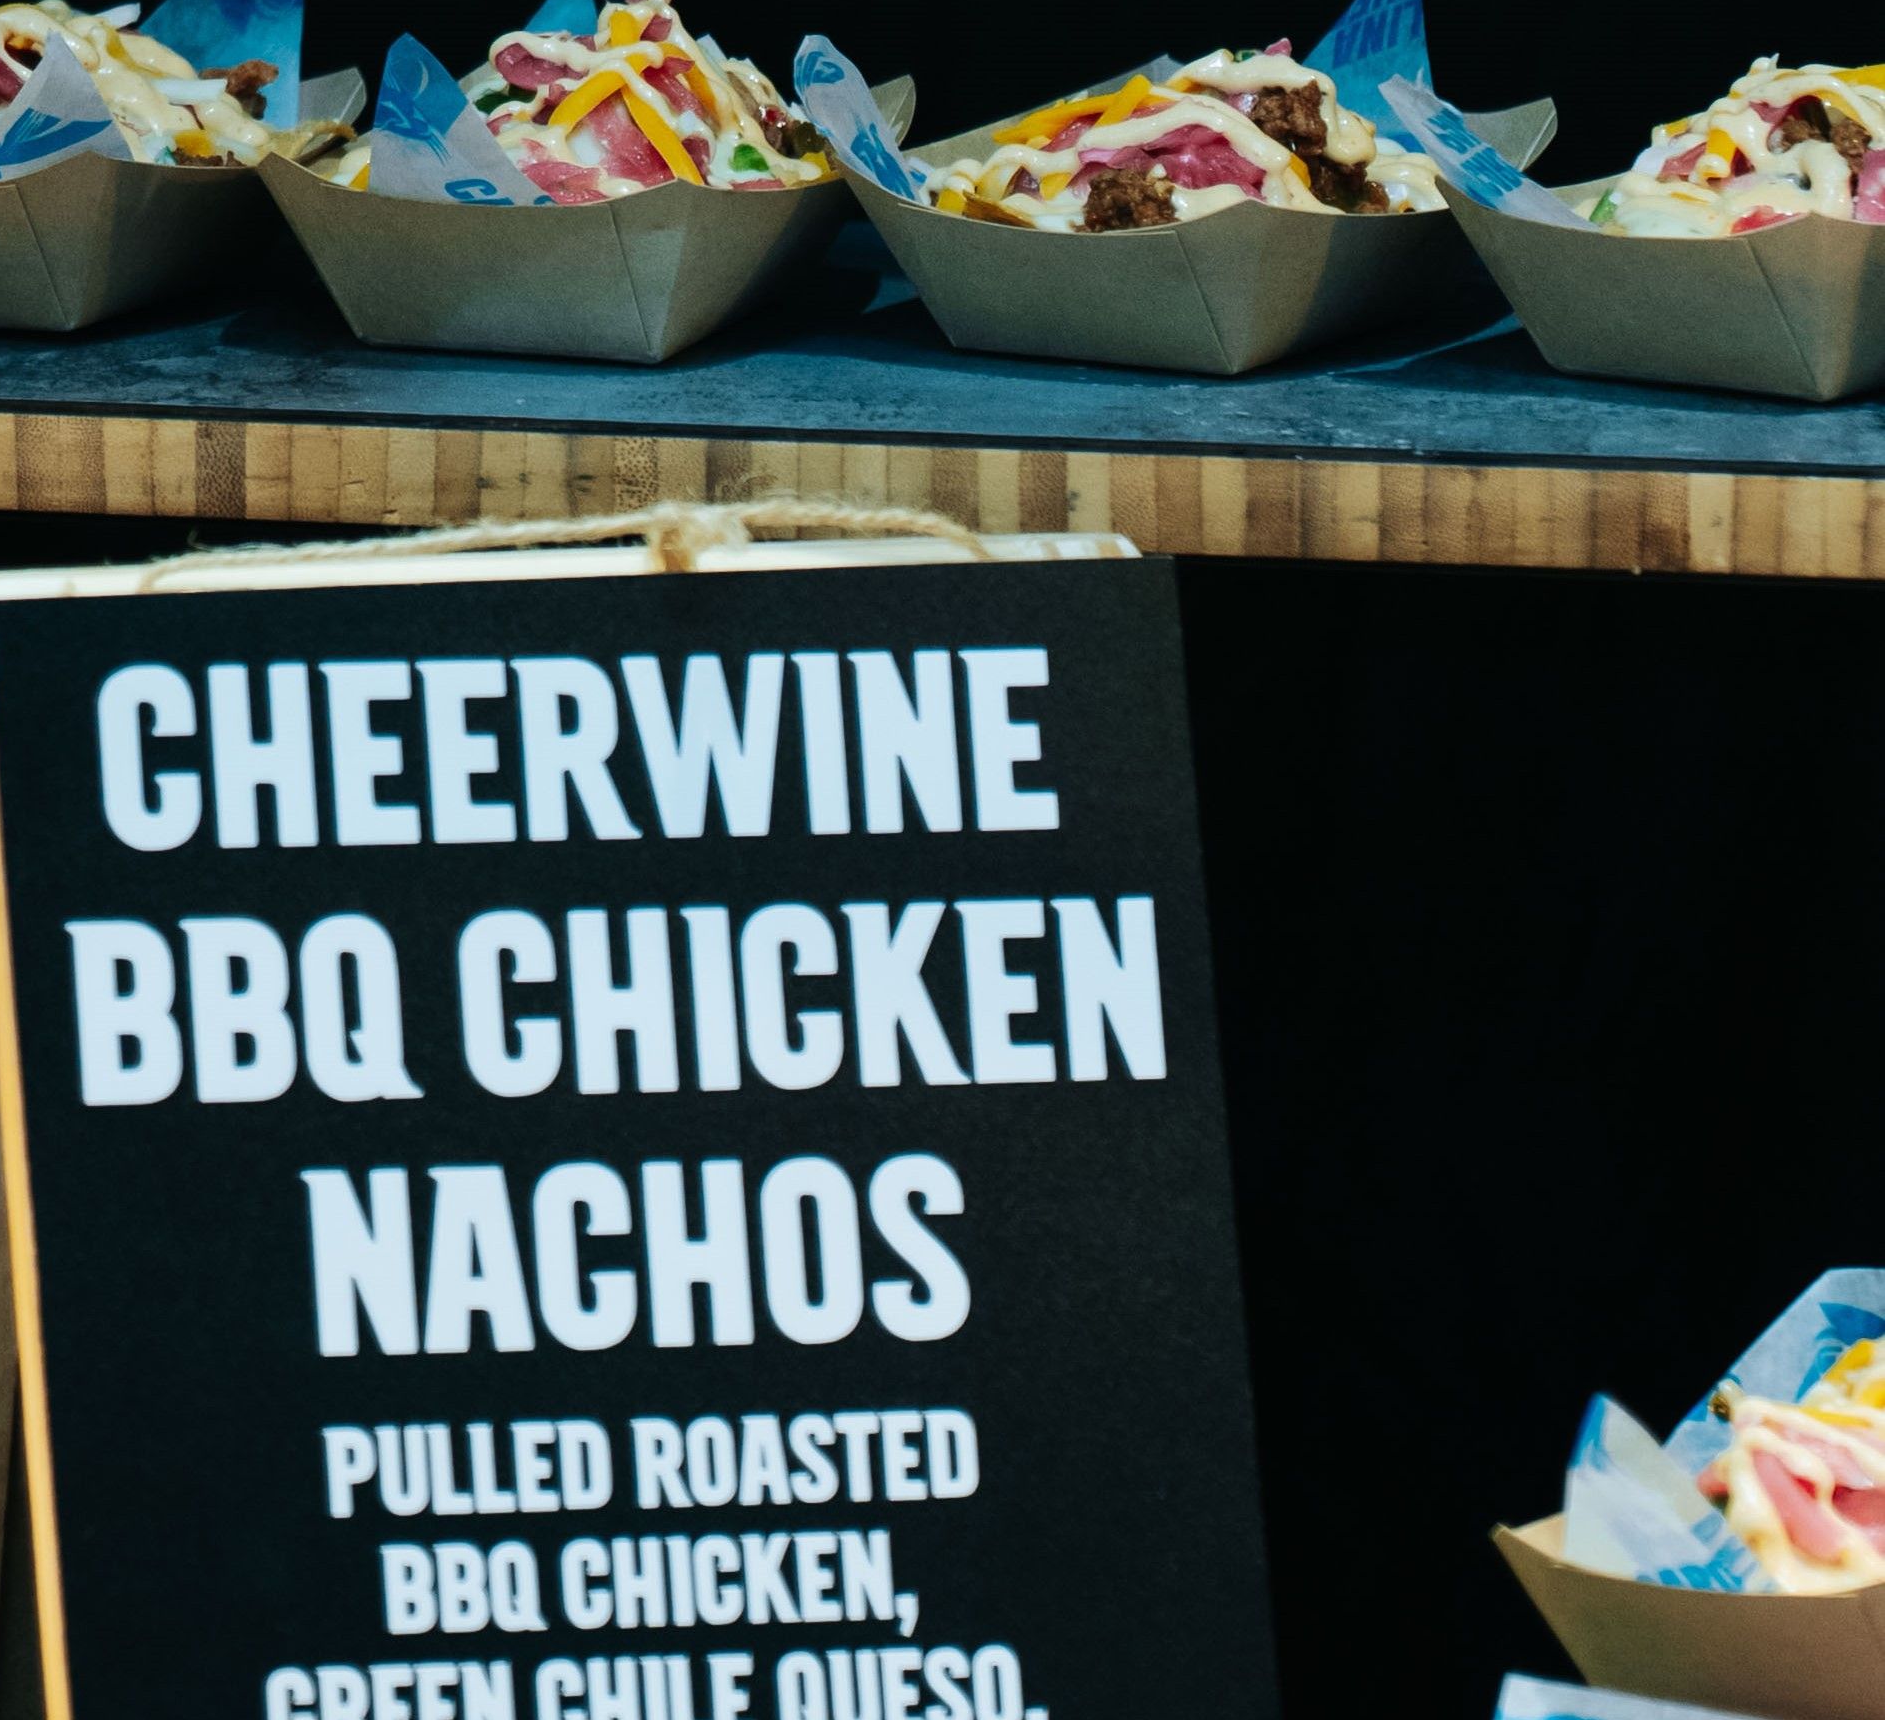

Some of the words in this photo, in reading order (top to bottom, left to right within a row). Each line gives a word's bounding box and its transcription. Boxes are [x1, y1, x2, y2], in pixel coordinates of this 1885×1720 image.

[98, 649, 1059, 851] CHEERWINE
[65, 914, 423, 1106] BBQ
[459, 897, 1166, 1097] CHICKEN
[301, 1154, 970, 1357] NACHOS
[323, 1420, 612, 1518] PULLED
[631, 1410, 979, 1509] ROASTED
[381, 1541, 547, 1634] BBQ
[561, 1530, 918, 1637] CHICKEN,
